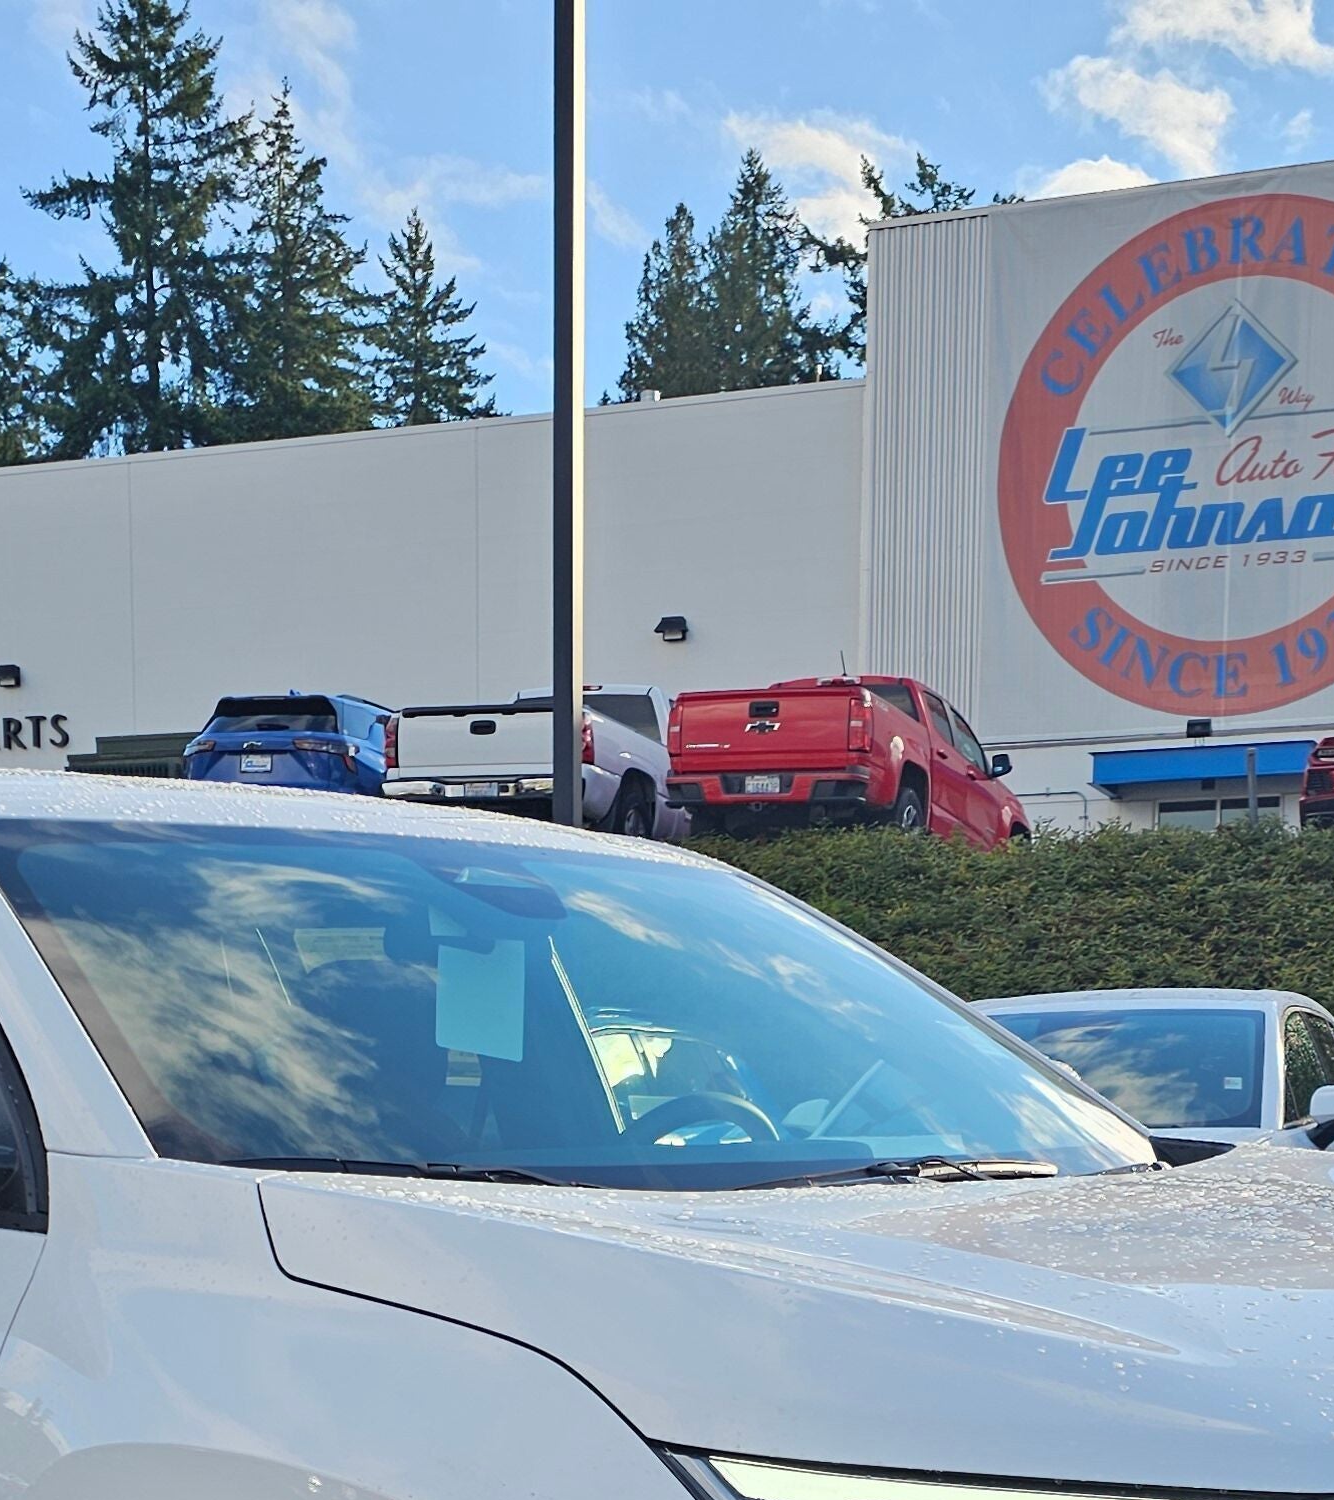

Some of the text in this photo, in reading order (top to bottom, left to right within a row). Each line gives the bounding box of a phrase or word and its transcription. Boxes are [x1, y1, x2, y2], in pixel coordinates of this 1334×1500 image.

[1152, 327, 1185, 348] The
[1278, 385, 1315, 411] Way
[1043, 427, 1197, 503] Lee
[1216, 434, 1304, 487] Auto
[1149, 549, 1308, 575] SINCE 1933
[1069, 606, 1249, 699] SINCE
